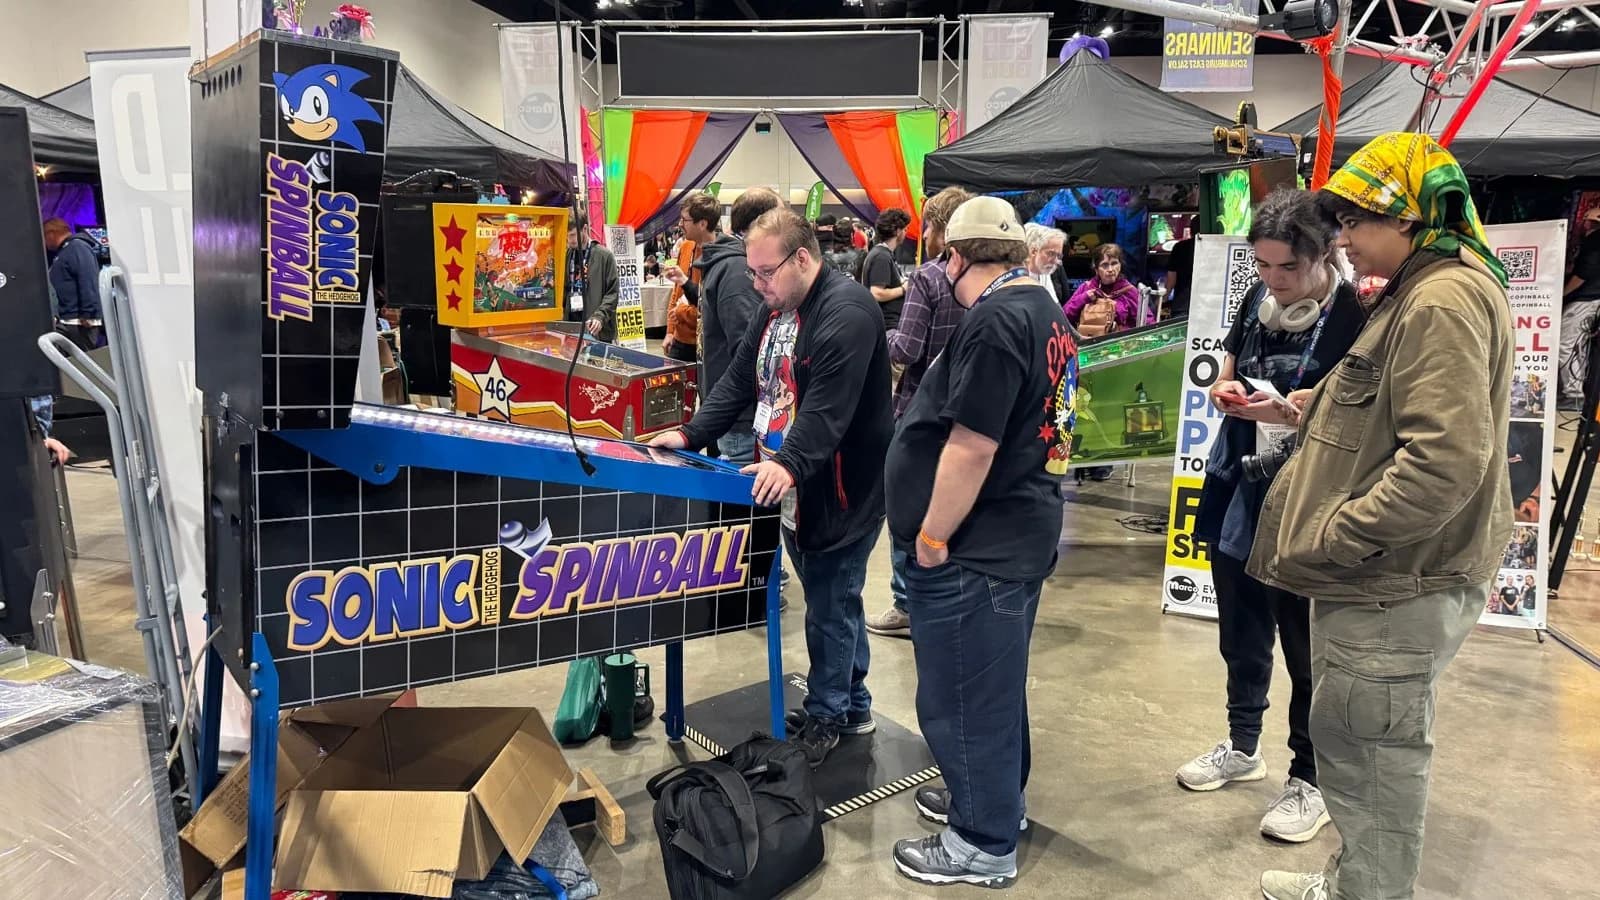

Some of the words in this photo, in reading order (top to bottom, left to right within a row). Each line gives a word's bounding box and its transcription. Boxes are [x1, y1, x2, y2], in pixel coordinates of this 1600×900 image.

[266, 152, 313, 322] SPINBALL
[315, 190, 360, 291] SONIC
[620, 277, 639, 288] BALL
[317, 291, 327, 301] THE
[328, 291, 359, 302] HEDGEHOG
[617, 309, 643, 328] FREE
[618, 326, 643, 338] SHIPPING
[1191, 338, 1227, 351] SCA
[1522, 354, 1549, 363] OUR
[485, 377, 506, 401] 46
[484, 550, 499, 604] HEDGEHOG
[509, 523, 751, 619] SPINBALL
[286, 554, 480, 651] SONIC
[484, 604, 497, 624] THE
